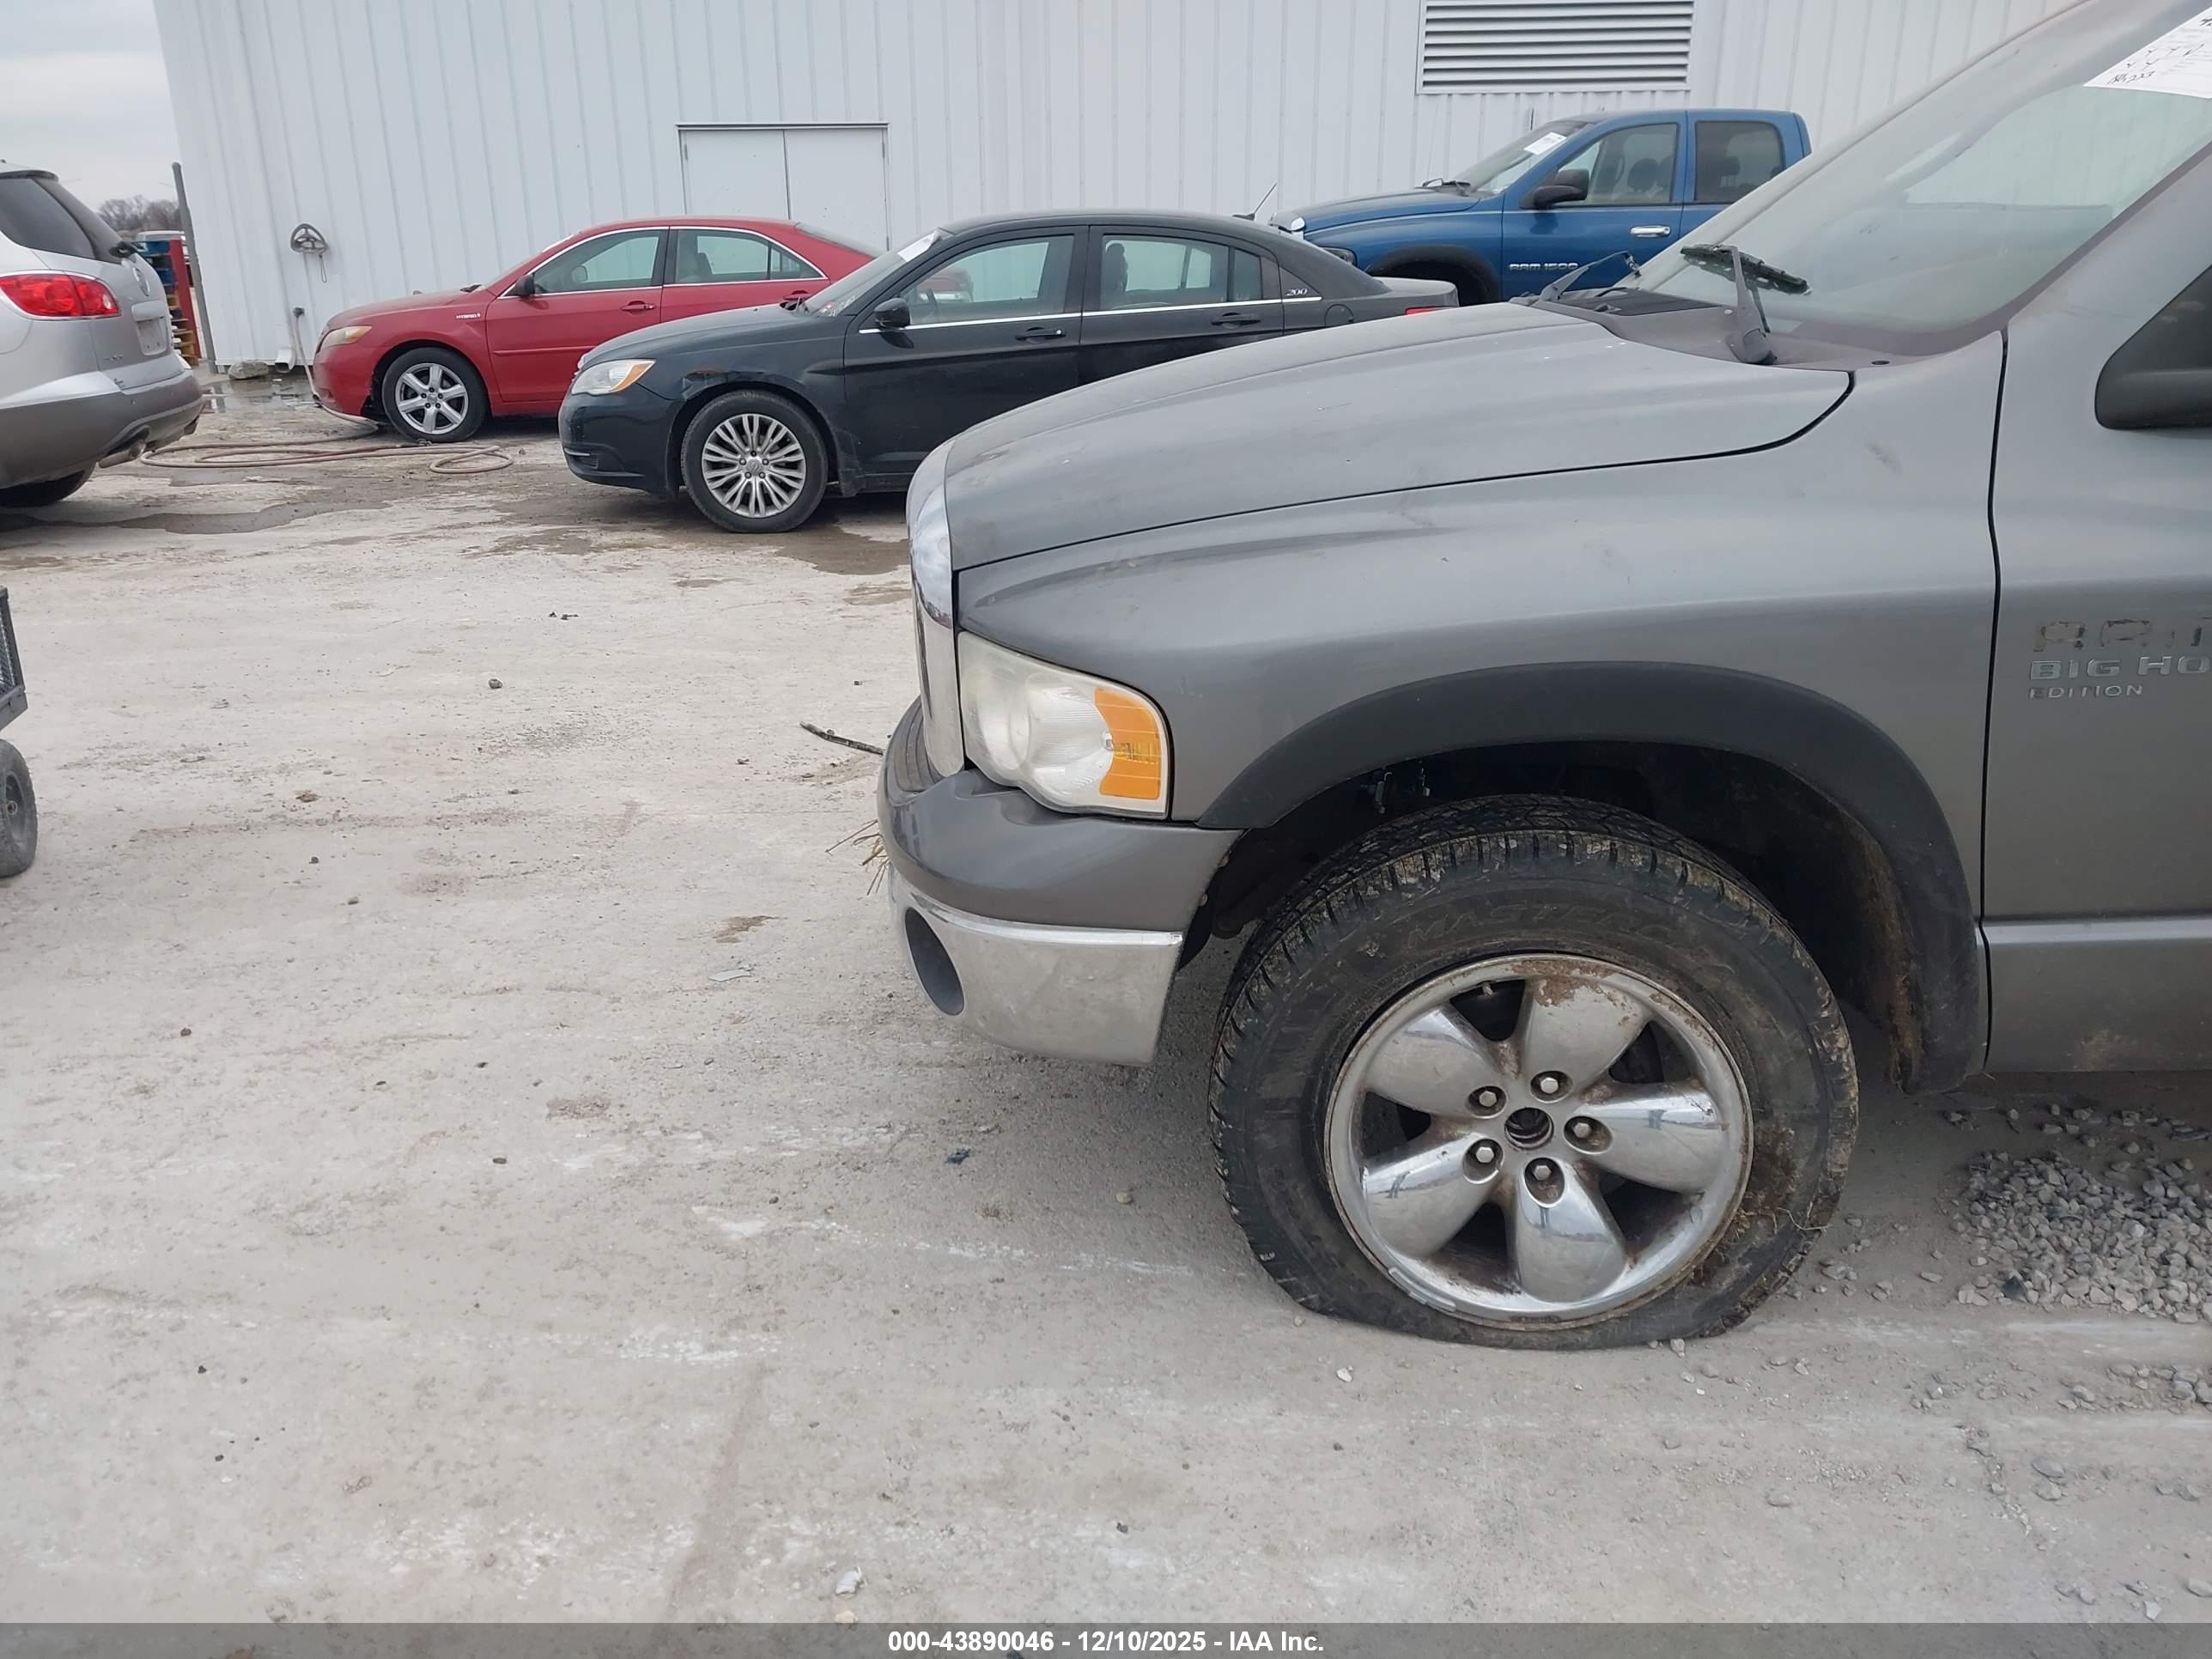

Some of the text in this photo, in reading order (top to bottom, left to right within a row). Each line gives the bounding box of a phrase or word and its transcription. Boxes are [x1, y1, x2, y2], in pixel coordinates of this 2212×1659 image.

[2030, 654, 2211, 680] BIG HO
[2028, 685, 2143, 699] EDITION
